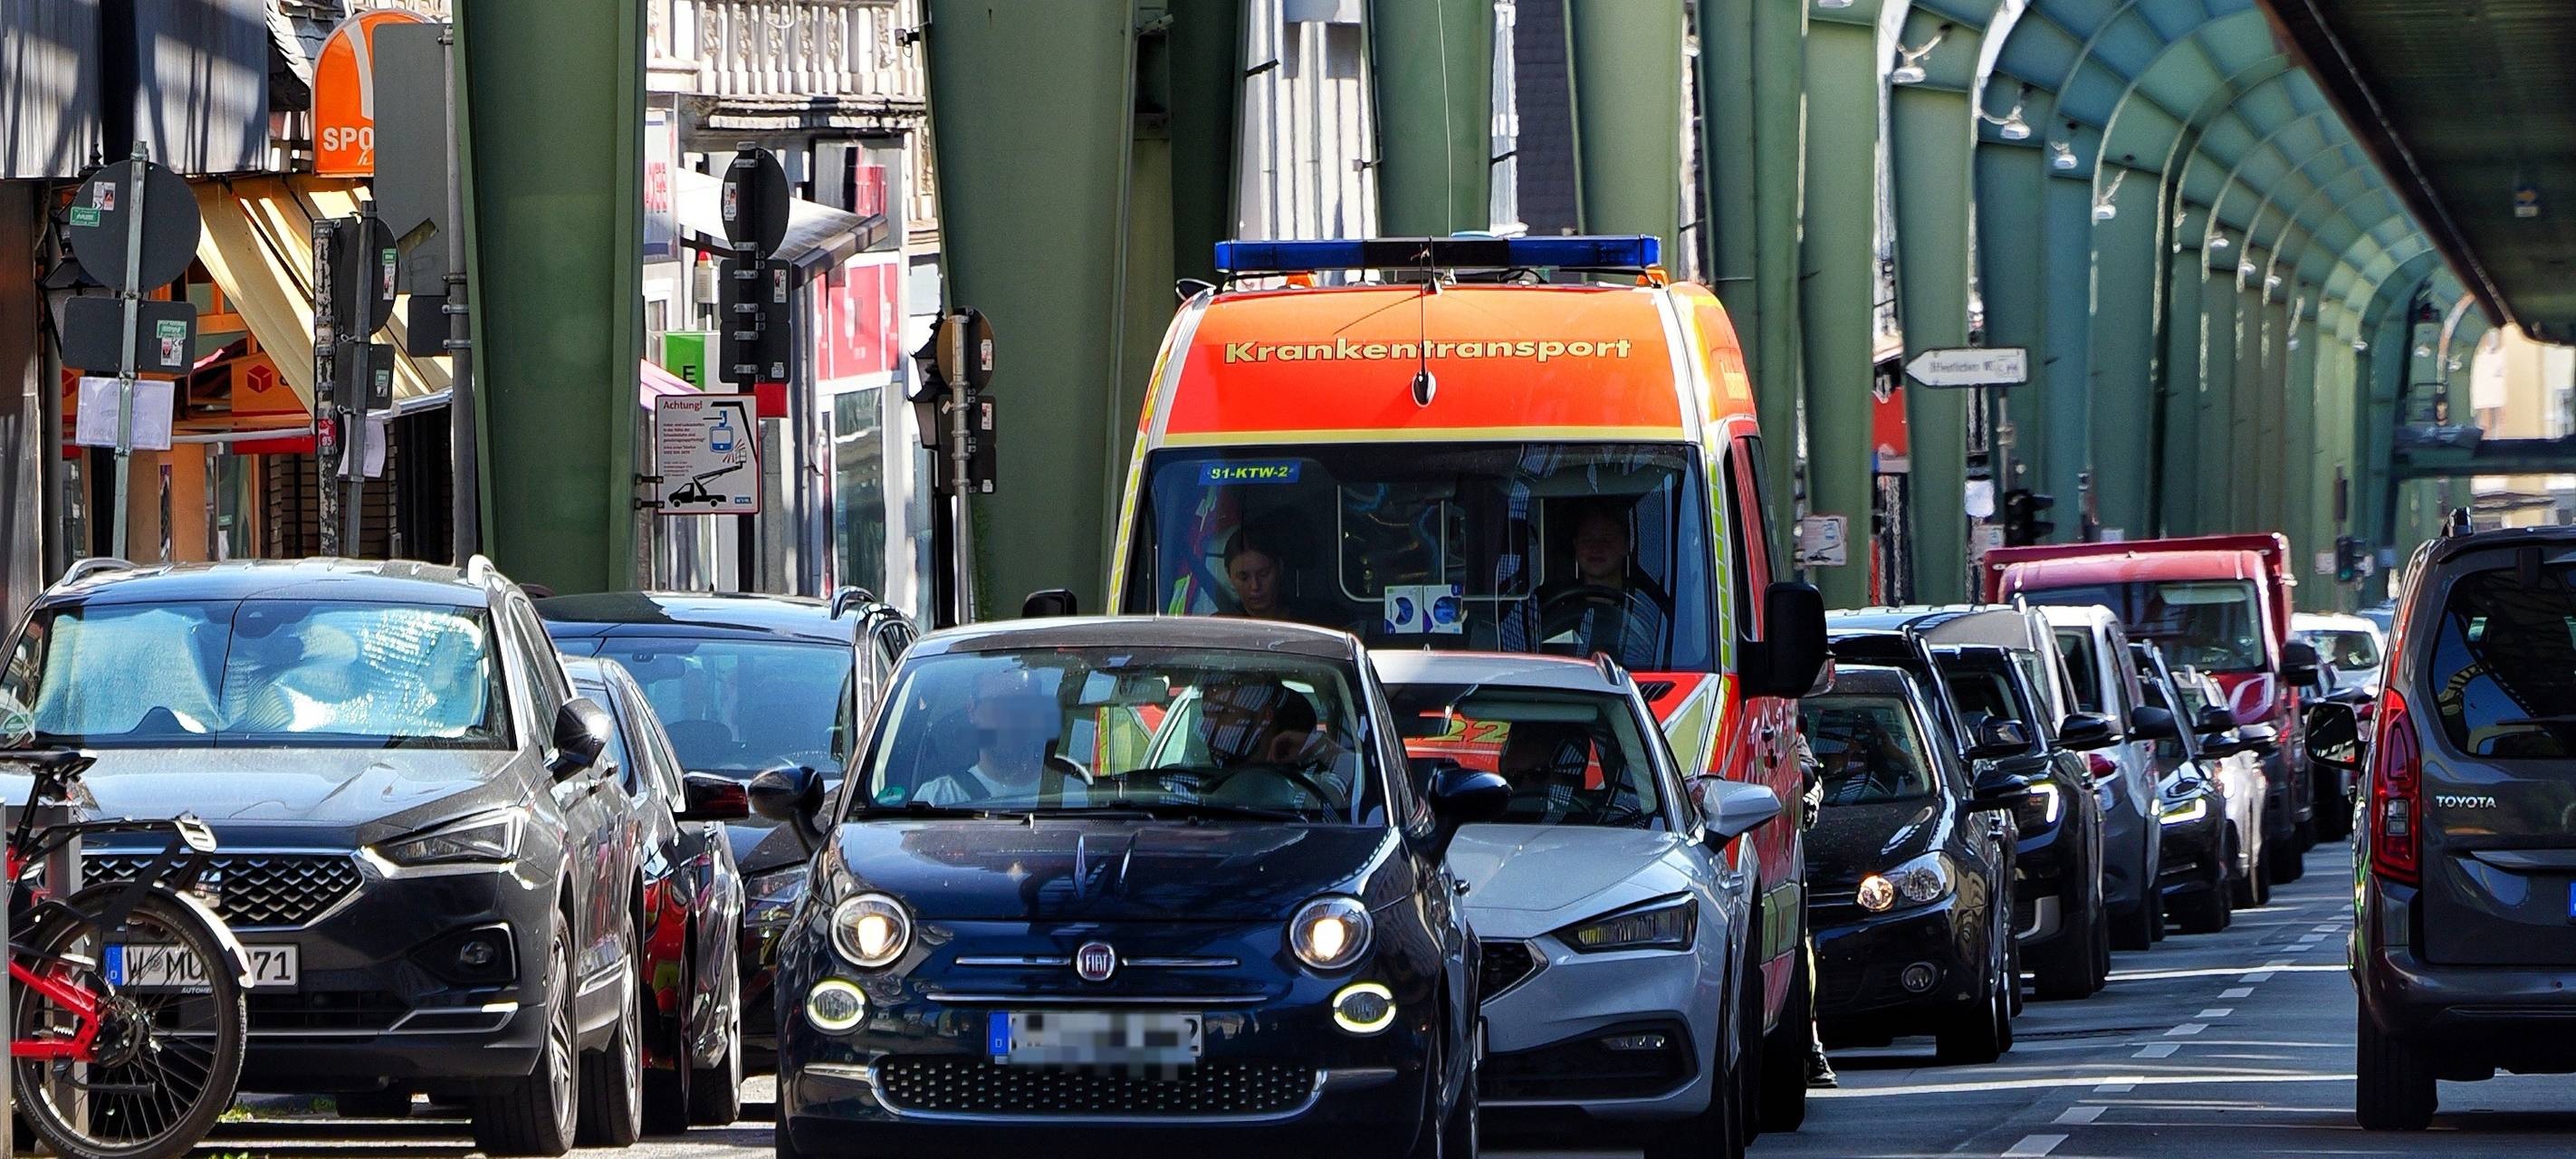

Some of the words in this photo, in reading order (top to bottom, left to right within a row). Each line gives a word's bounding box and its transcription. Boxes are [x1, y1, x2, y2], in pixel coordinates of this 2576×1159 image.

[1224, 338, 1632, 363] Krankentransport
[663, 400, 703, 411] Achtung!
[2436, 796, 2497, 809] TOYOTA
[1087, 953, 1108, 972] FIAT
